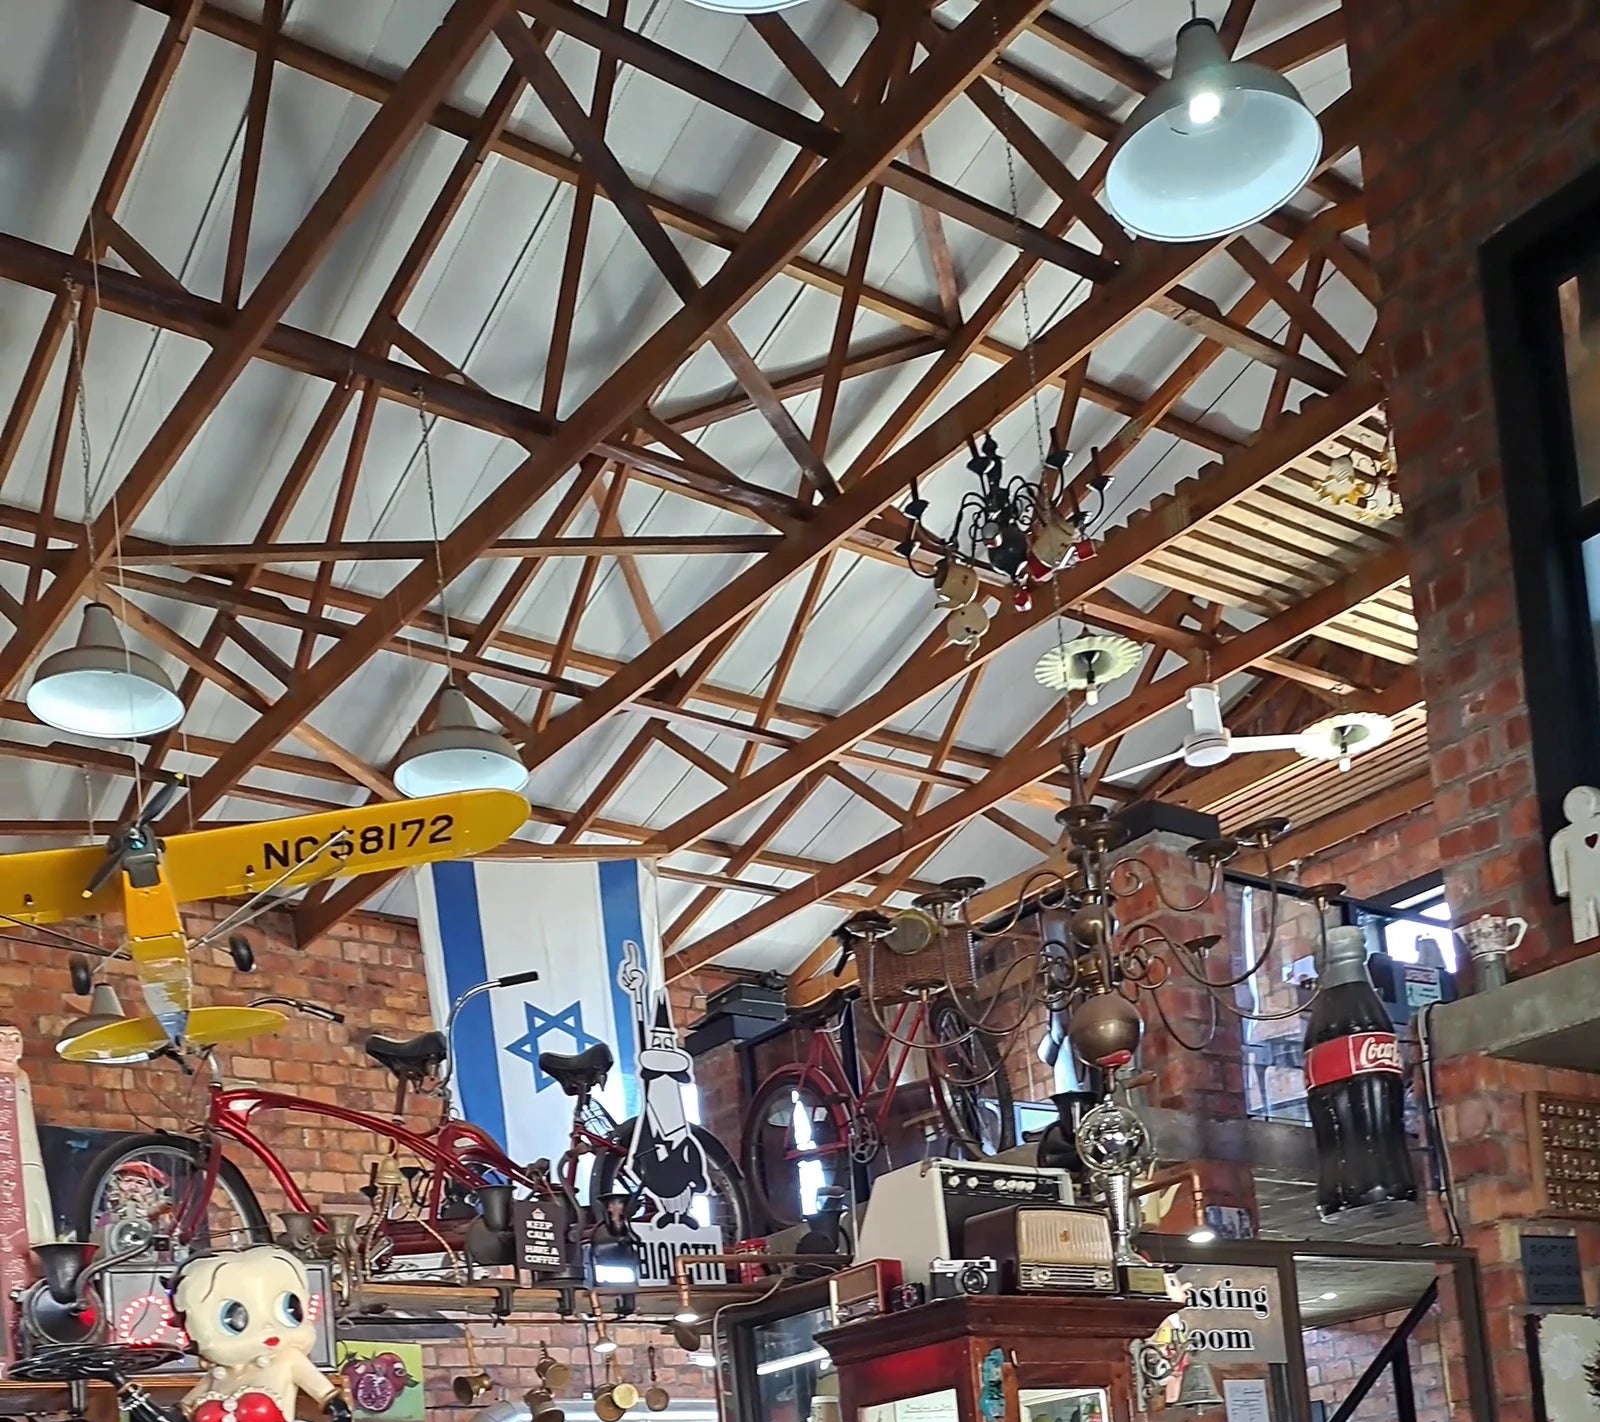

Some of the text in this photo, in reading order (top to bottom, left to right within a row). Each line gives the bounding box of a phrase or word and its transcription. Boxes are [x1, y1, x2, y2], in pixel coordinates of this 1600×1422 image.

[263, 814, 454, 870] NC58172
[526, 1220, 553, 1230] KEEP
[526, 1230, 555, 1241] CALM
[524, 1254, 561, 1266] COFFEE
[1184, 1279, 1268, 1317] asting
[1180, 1320, 1253, 1350] oom
